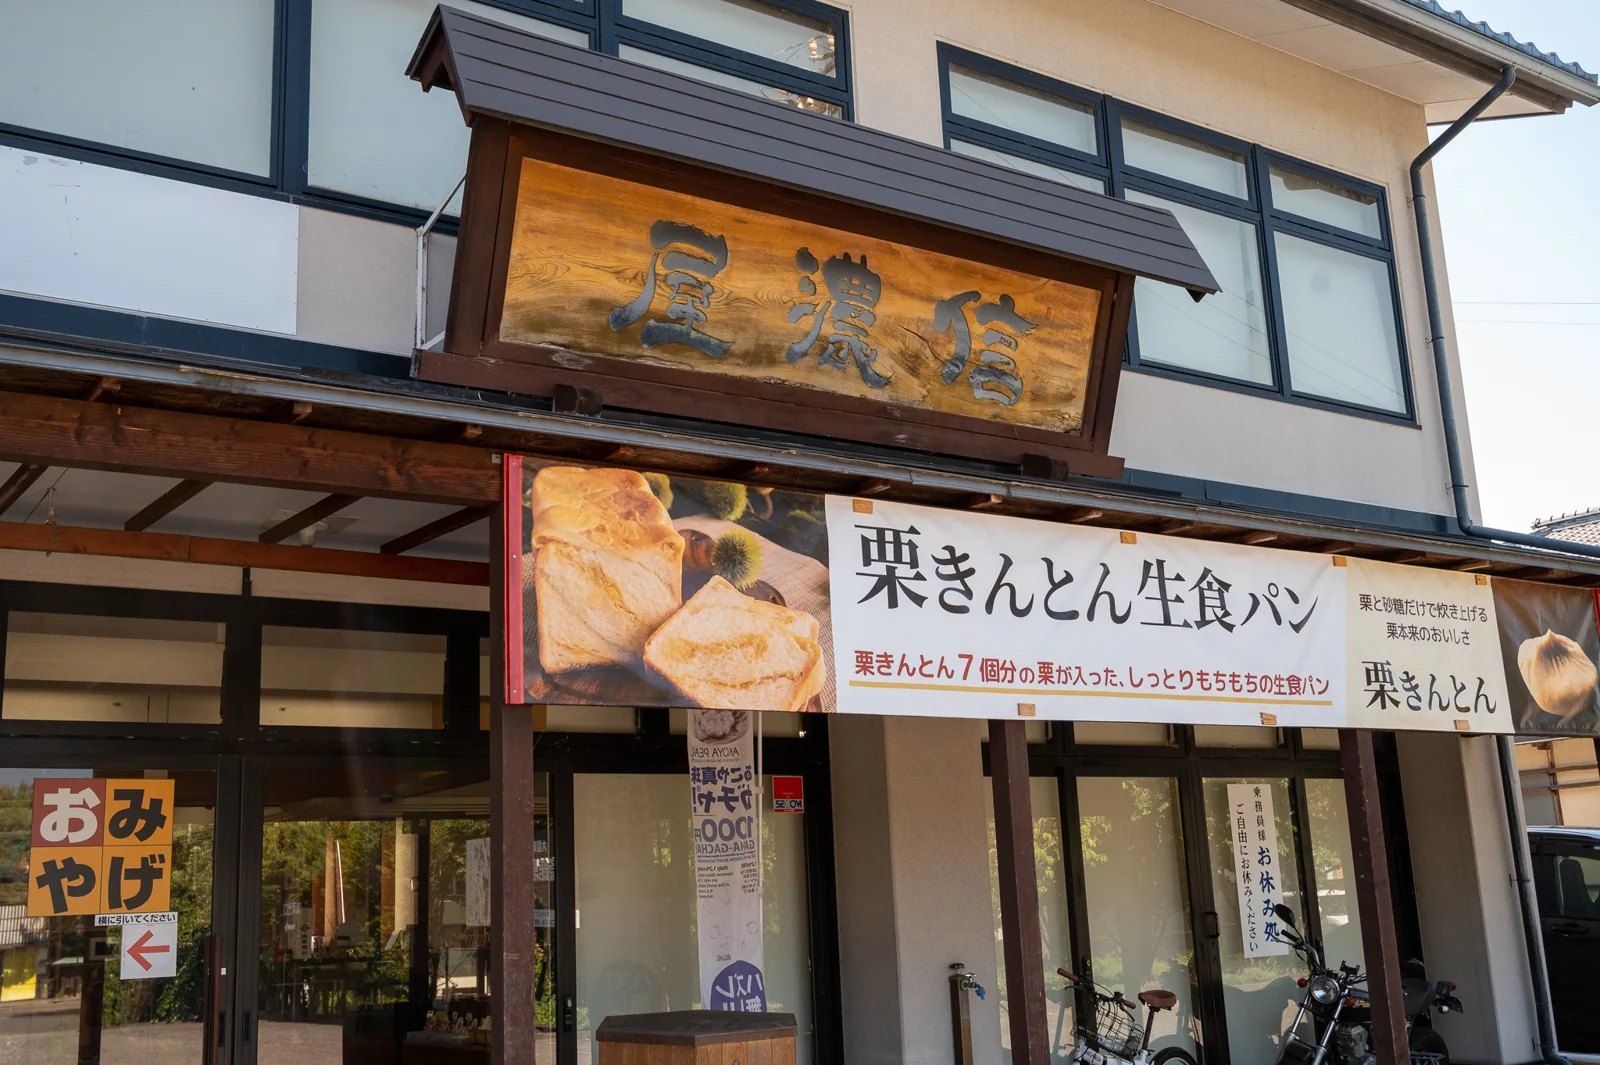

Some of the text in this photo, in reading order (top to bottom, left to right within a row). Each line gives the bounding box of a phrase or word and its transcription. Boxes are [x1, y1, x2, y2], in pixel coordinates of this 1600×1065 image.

[854, 523, 1319, 634] 栗きんとん生食パン
[1358, 593, 1488, 623] 栗と砂糖だけで炊き上げる
[1386, 621, 1471, 646] 栗本来のおいしさ
[1361, 659, 1497, 714] 栗きんとん
[775, 799, 802, 809] SECOM
[1236, 803, 1259, 952] ご自由にお休みください
[97, 913, 176, 925] 横に引いてください
